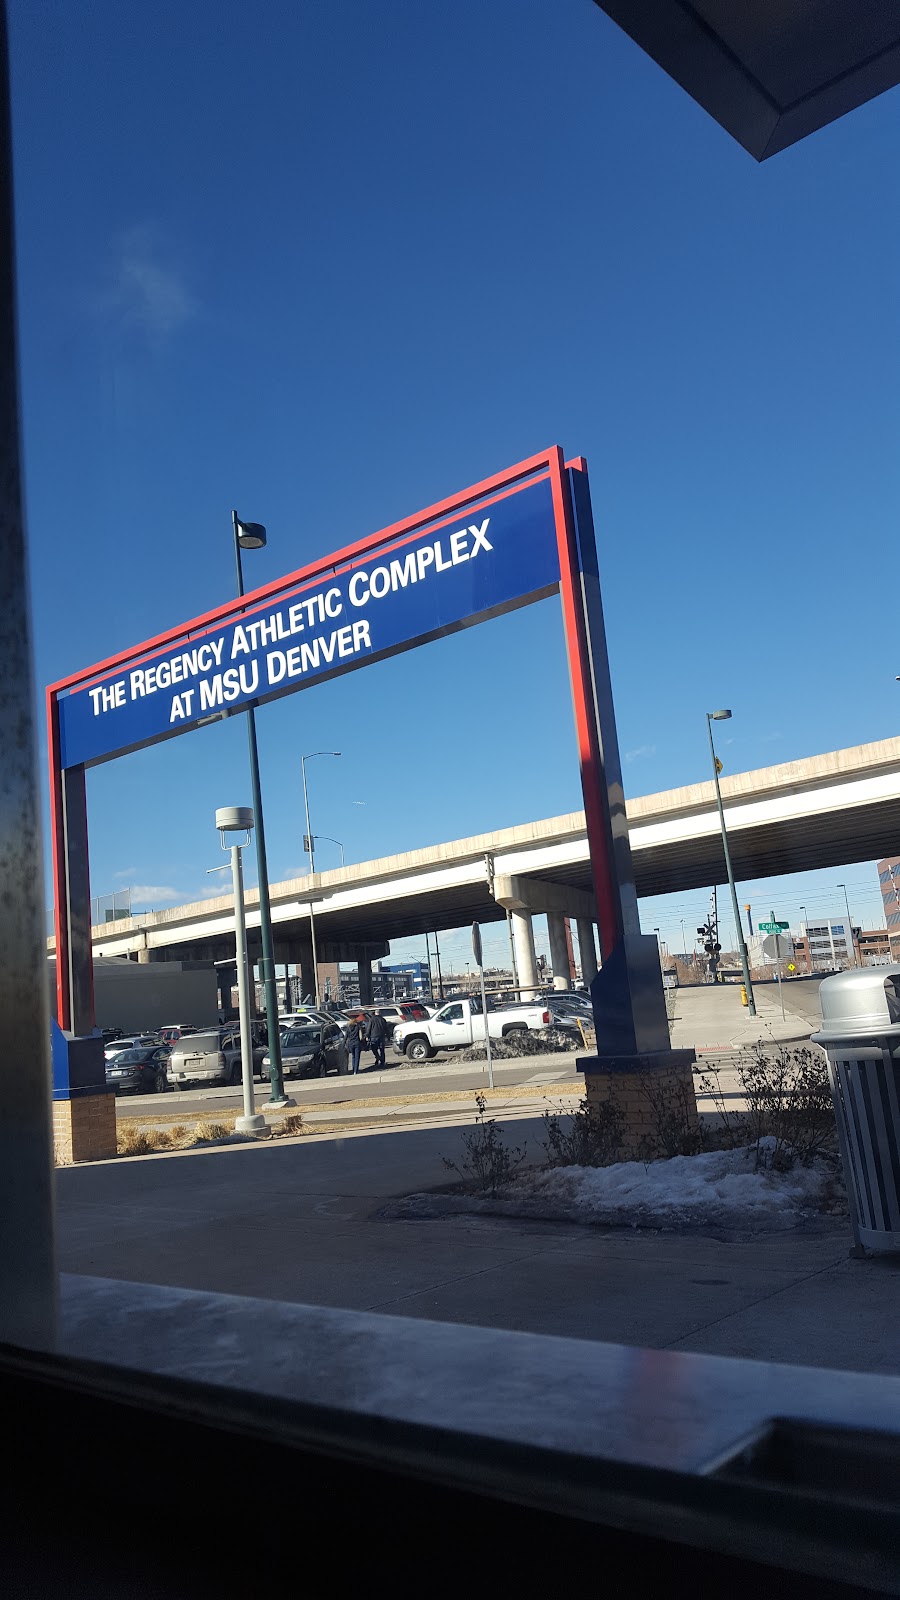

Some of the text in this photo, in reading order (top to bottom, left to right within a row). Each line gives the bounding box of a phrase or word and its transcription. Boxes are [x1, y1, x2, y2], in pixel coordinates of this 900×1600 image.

[88, 518, 494, 717] THE REGENCY ATHLETIC COMPLEX
[169, 619, 372, 723] AT MSU DENVER
